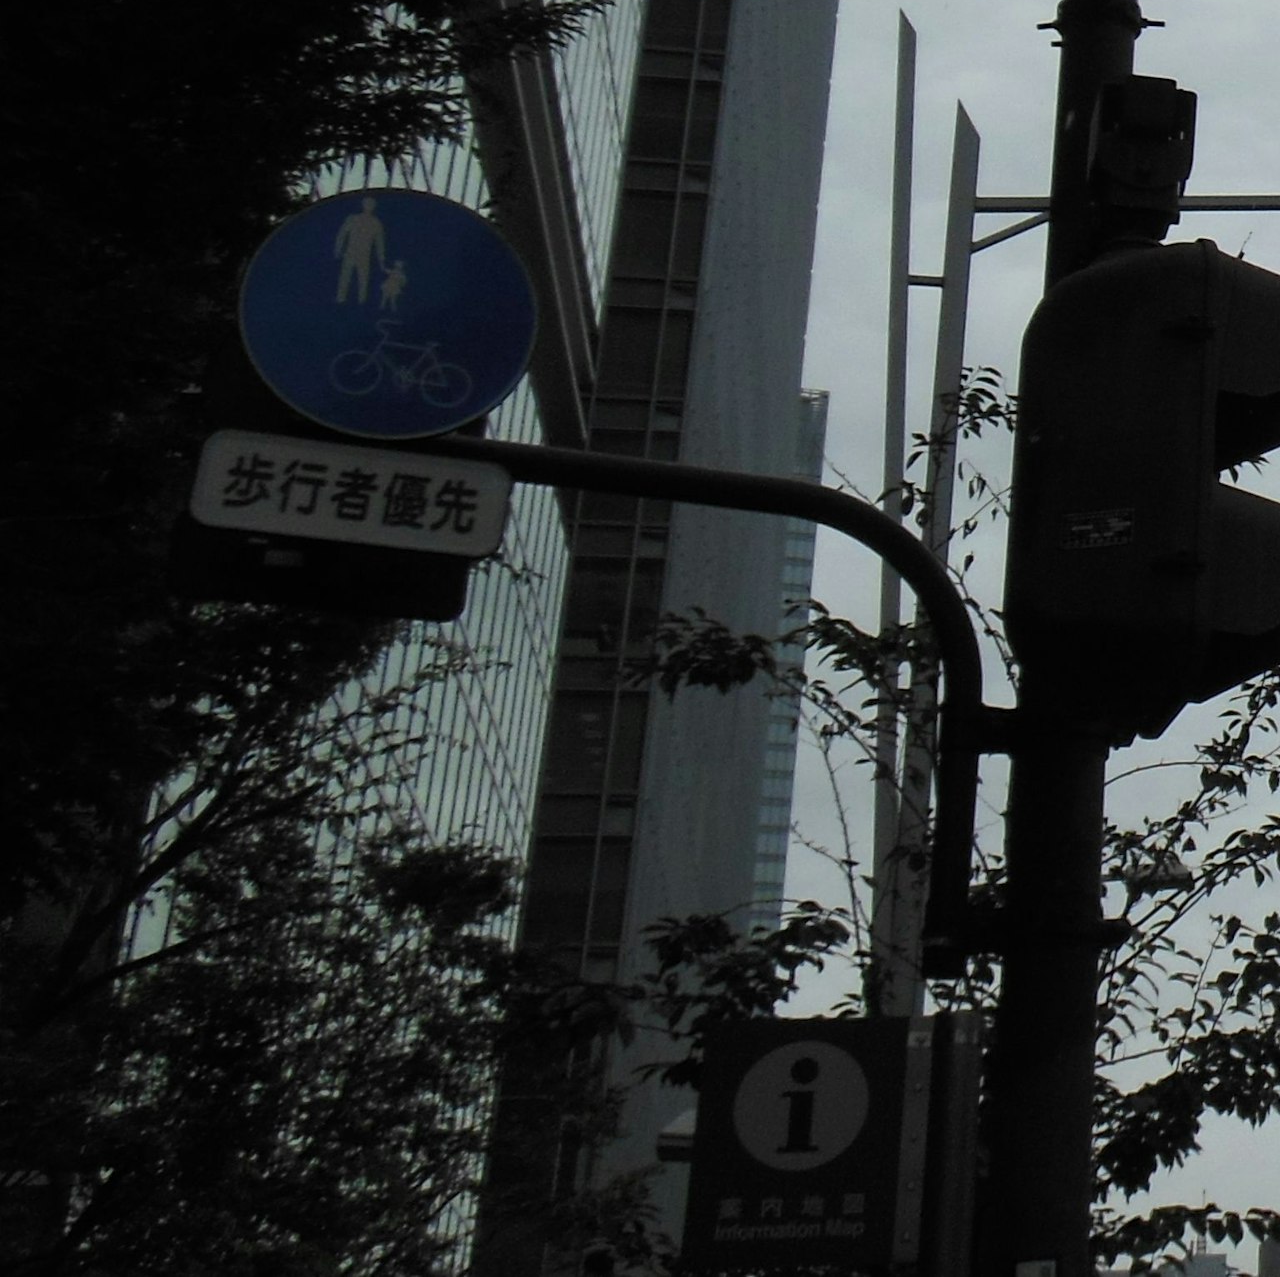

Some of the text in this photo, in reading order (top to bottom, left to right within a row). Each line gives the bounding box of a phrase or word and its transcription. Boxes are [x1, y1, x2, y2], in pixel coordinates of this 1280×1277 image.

[224, 454, 478, 533] 歩行者優先
[713, 1218, 866, 1241] Information Map
